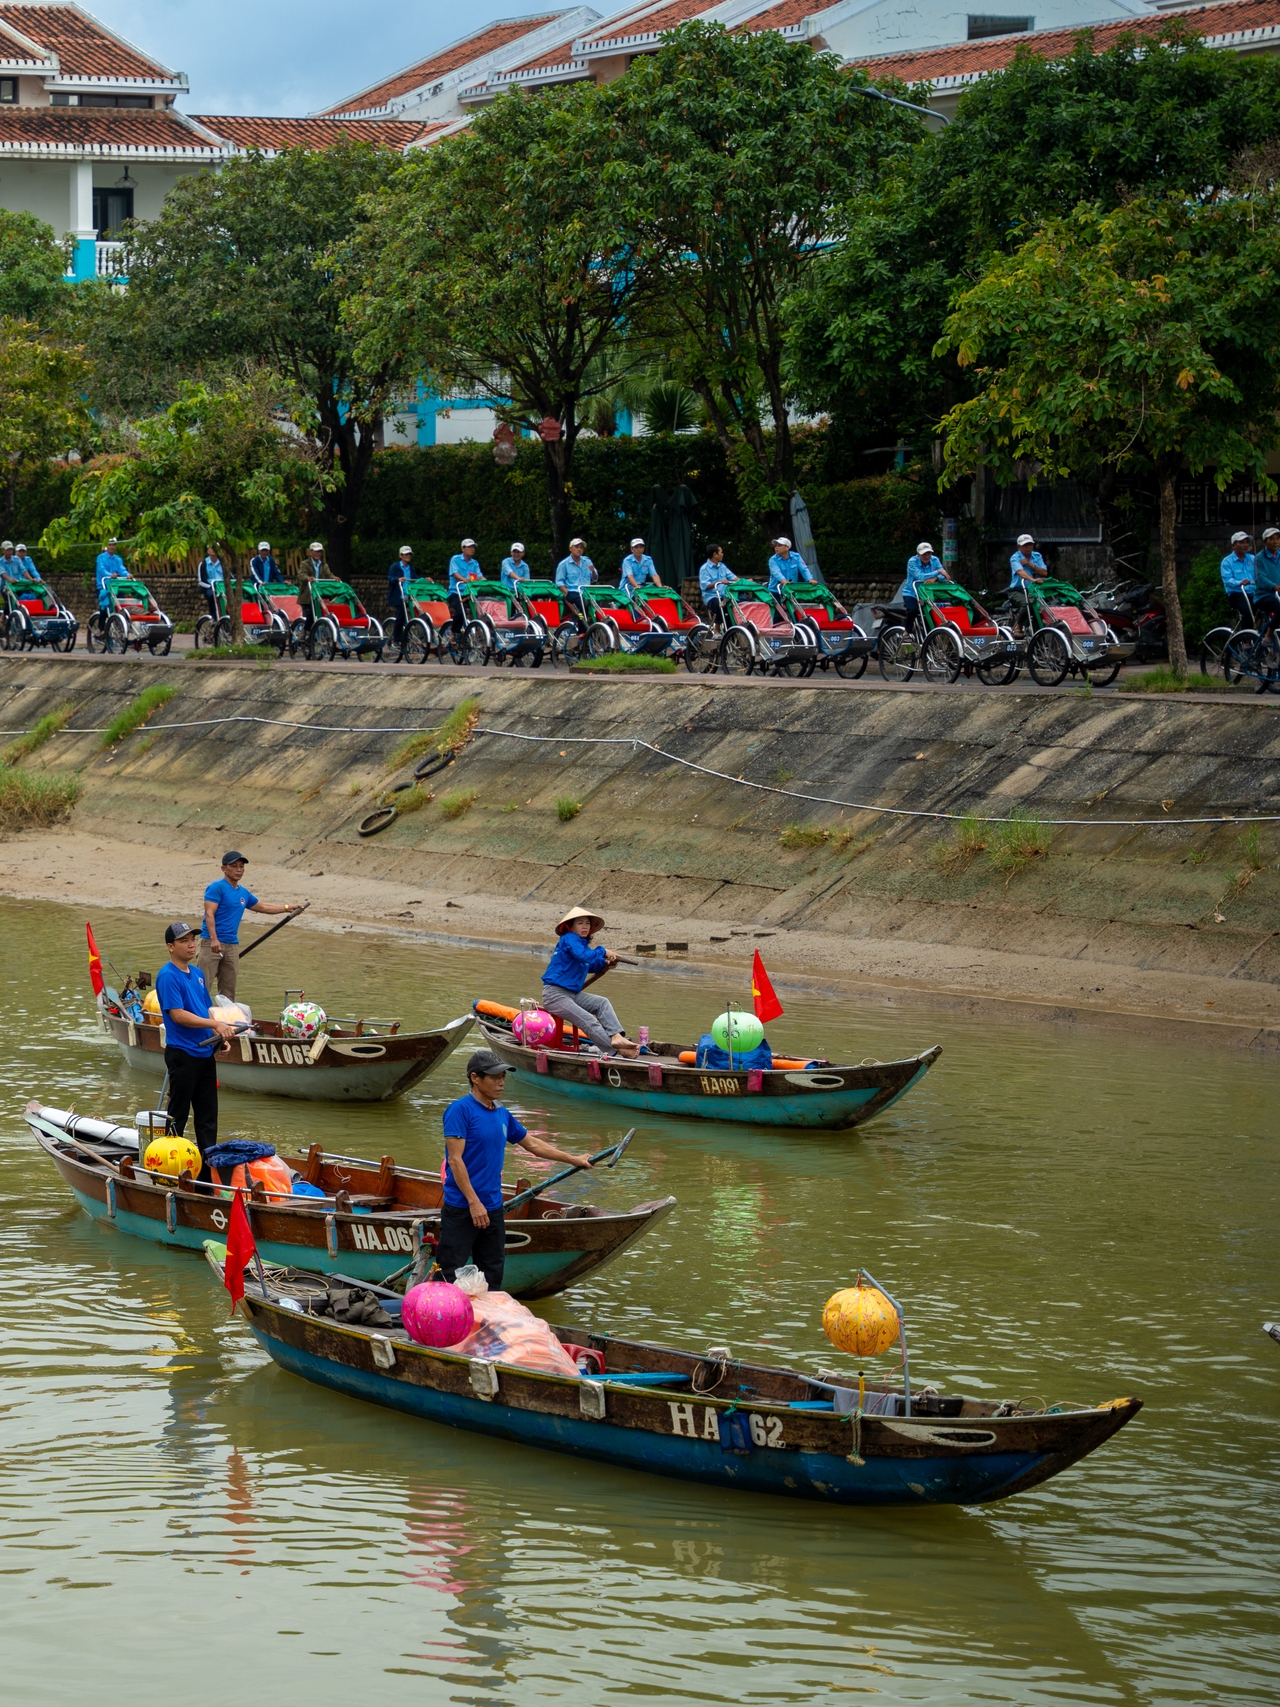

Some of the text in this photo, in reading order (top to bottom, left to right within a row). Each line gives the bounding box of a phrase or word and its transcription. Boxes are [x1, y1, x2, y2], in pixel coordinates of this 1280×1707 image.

[973, 637, 985, 645] 025
[1006, 644, 1018, 652] 025
[351, 1223, 415, 1252] HA.06
